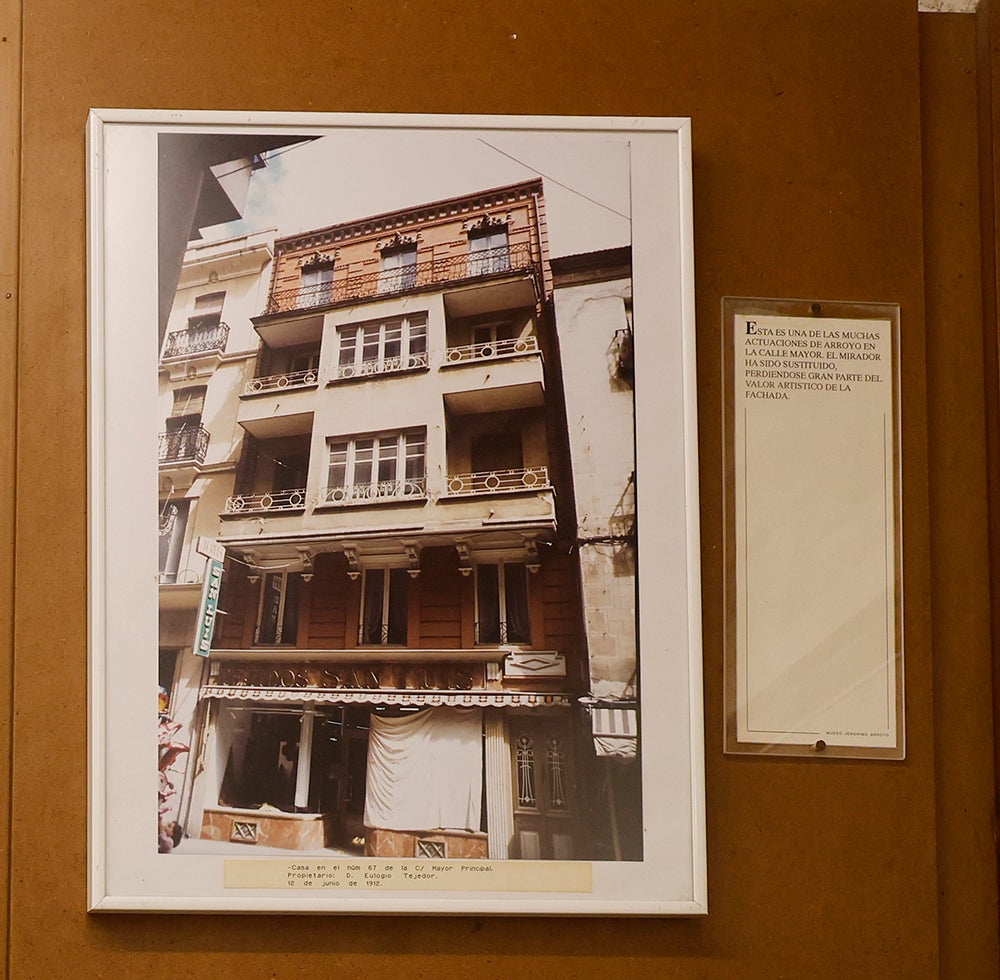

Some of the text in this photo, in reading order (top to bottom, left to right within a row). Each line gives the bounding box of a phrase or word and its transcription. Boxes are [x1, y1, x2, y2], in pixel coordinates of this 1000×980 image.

[745, 321, 880, 340] ESTA ES UNA DE LAS MUCHAS
[744, 337, 875, 350] ACTUACIONES DE ARROYO EN
[745, 347, 881, 361] LA CALLE MAYOR. EL MIRADOR
[745, 358, 837, 370] HA SIDO SUSTITUIDO,
[745, 369, 882, 382] PERDIENDOSE GRAN PARTE DEL
[745, 379, 851, 392] VALOR ARTISTICO DE LA
[745, 390, 790, 399] FACHADA.
[207, 566, 222, 601] SAN
[199, 603, 215, 653] LUIS
